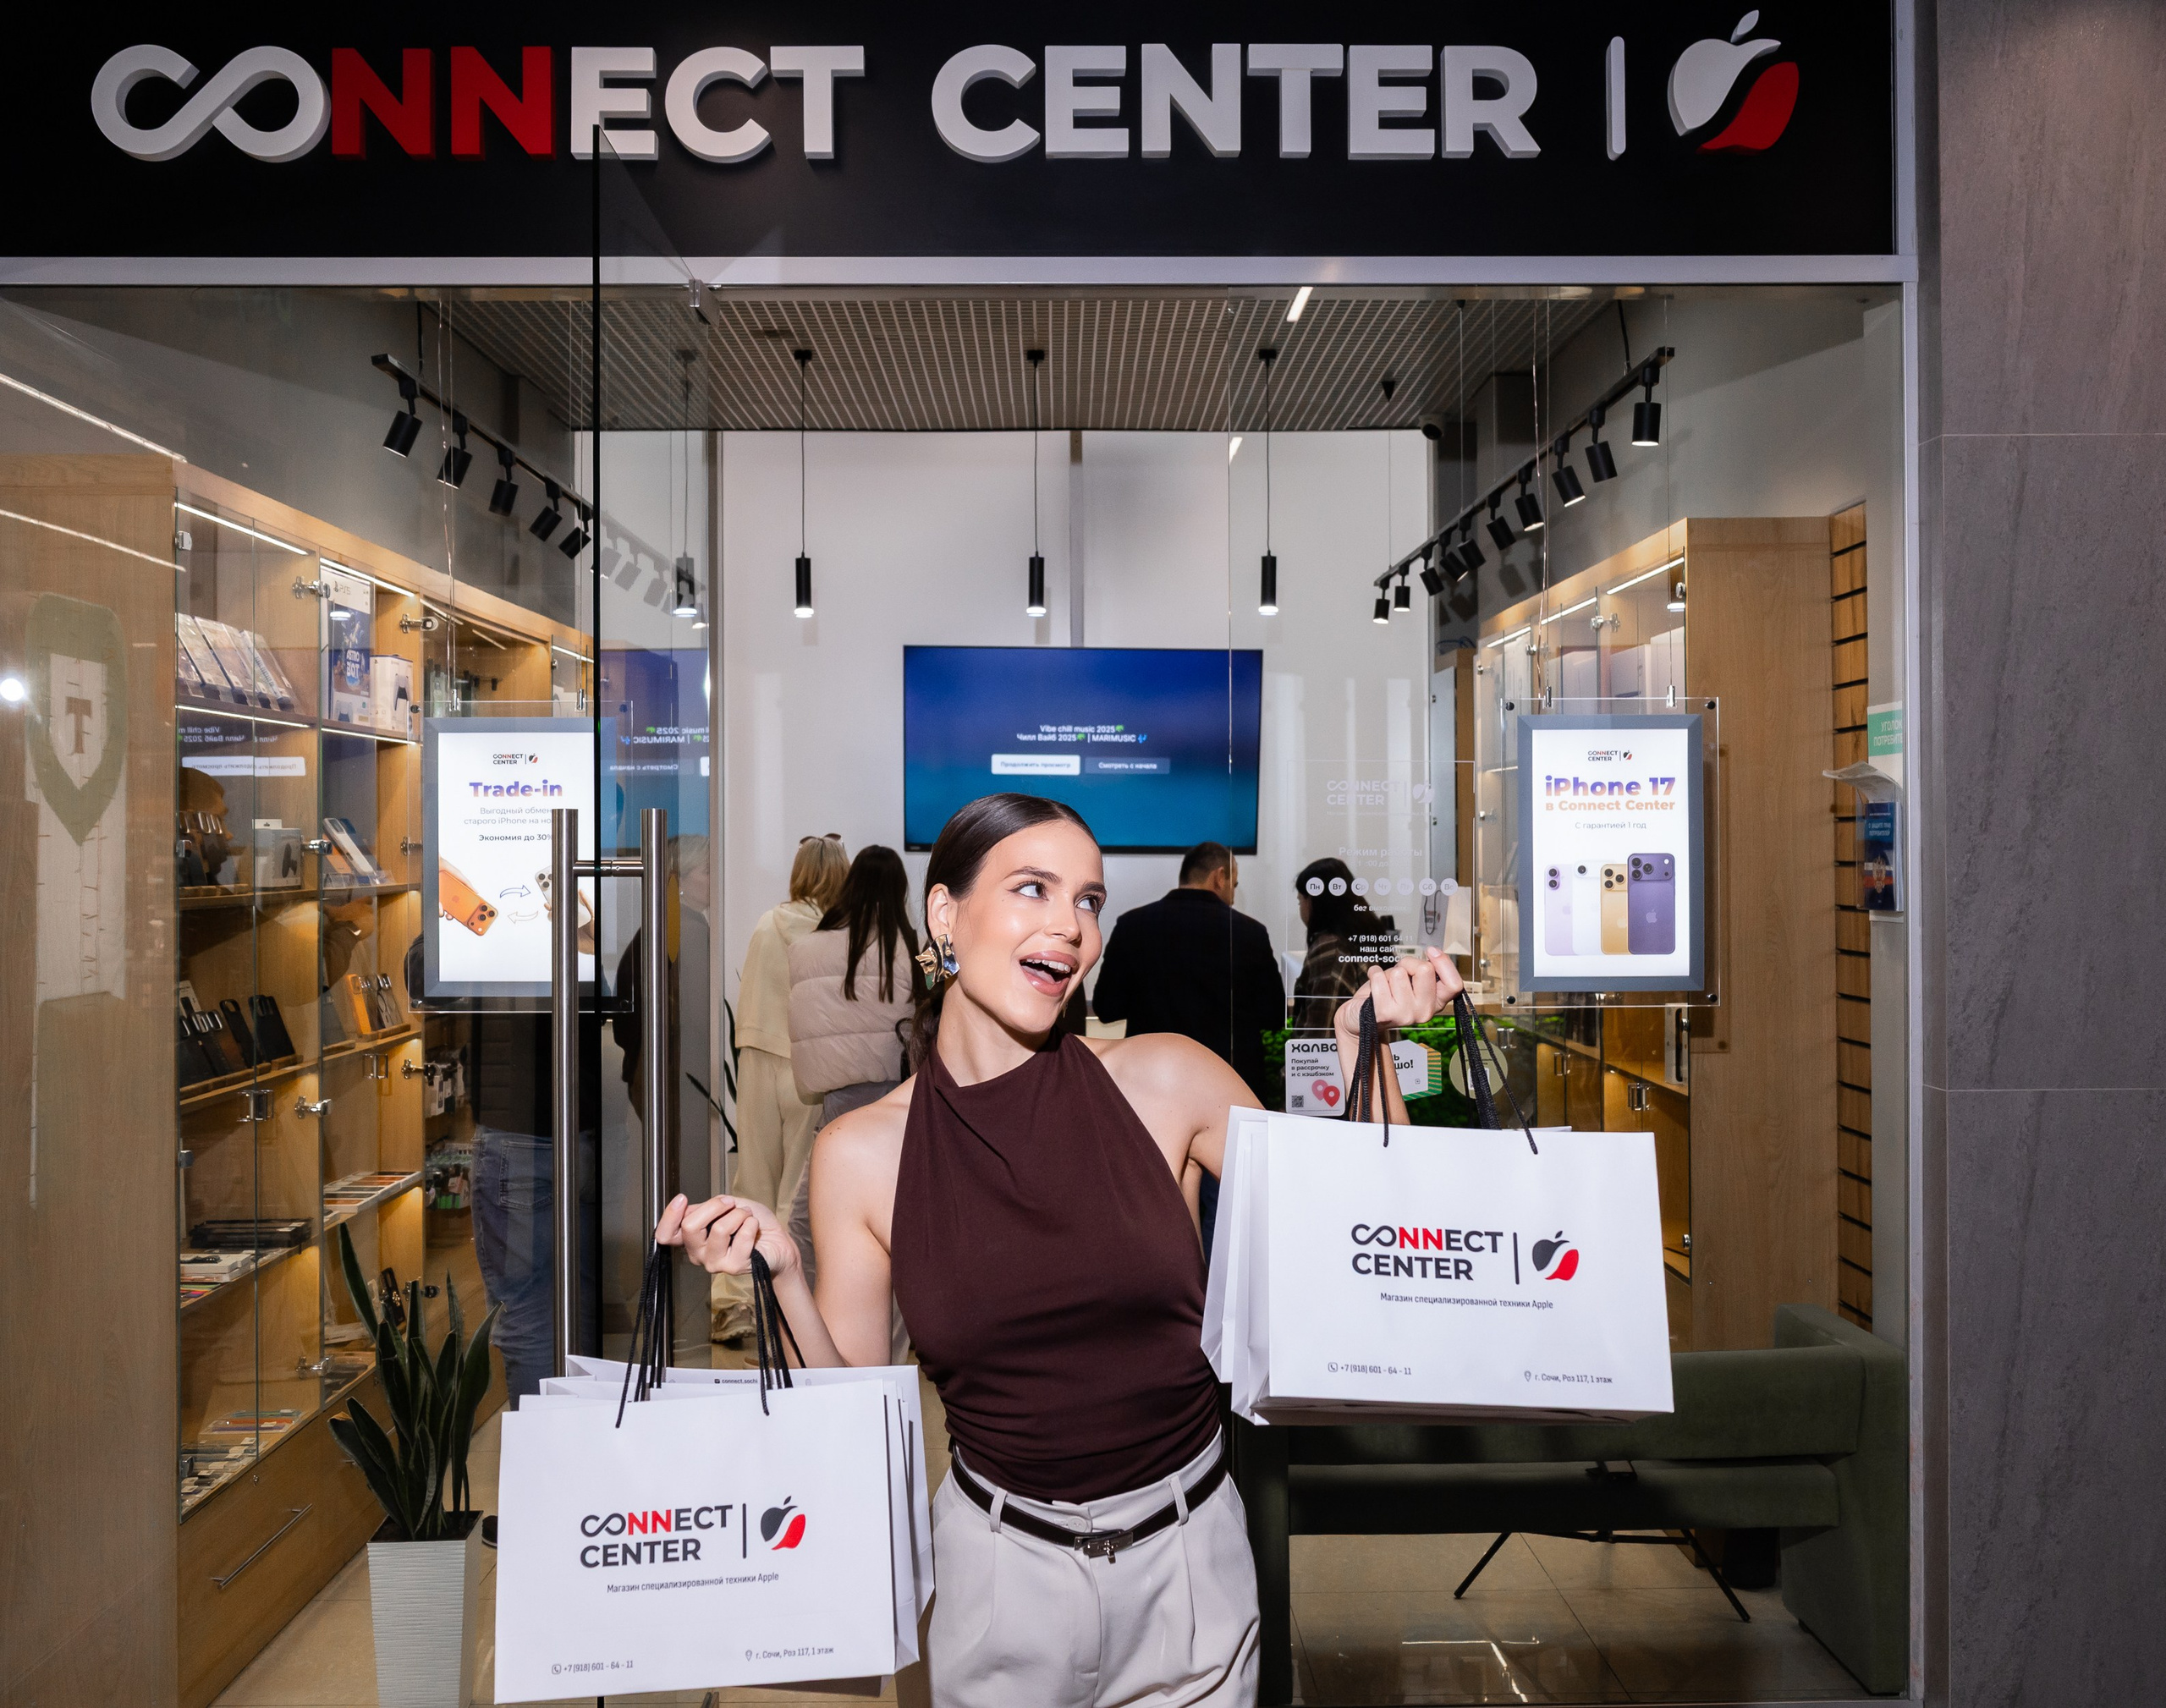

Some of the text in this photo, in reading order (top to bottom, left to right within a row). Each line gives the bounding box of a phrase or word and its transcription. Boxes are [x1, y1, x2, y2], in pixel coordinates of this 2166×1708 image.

[91, 42, 1541, 162] CONNECT CENTER
[346, 661, 360, 678] BOT
[469, 779, 563, 797] Trade-in
[1545, 775, 1675, 796] iPhone 17
[1559, 800, 1621, 810] Connect
[1625, 799, 1675, 810] Center
[1583, 821, 1626, 830] гарантией
[1339, 847, 1377, 856] Режим
[1359, 935, 1377, 943] (918)
[1350, 1223, 1504, 1253] CONNECT
[1351, 1252, 1474, 1282] CENTER
[1380, 1292, 1553, 1311] Магазин специализированной техники Apple
[1340, 1364, 1350, 1372] +7
[1350, 1364, 1367, 1374] (918)
[1369, 1365, 1382, 1374] 601
[1542, 1374, 1561, 1383] Сочи,
[1576, 1375, 1589, 1384] 117,
[580, 1504, 733, 1538] CONNECT
[580, 1538, 701, 1568] CENTER
[607, 1572, 779, 1594] Магазин специализированной техники Apple
[762, 1650, 782, 1661] Сочи,
[783, 1650, 796, 1658] Роз
[797, 1648, 810, 1657] 117,
[573, 1663, 591, 1673] (918)
[591, 1662, 604, 1672] 601
[610, 1661, 619, 1670] 64
[626, 1661, 633, 1669] 11
